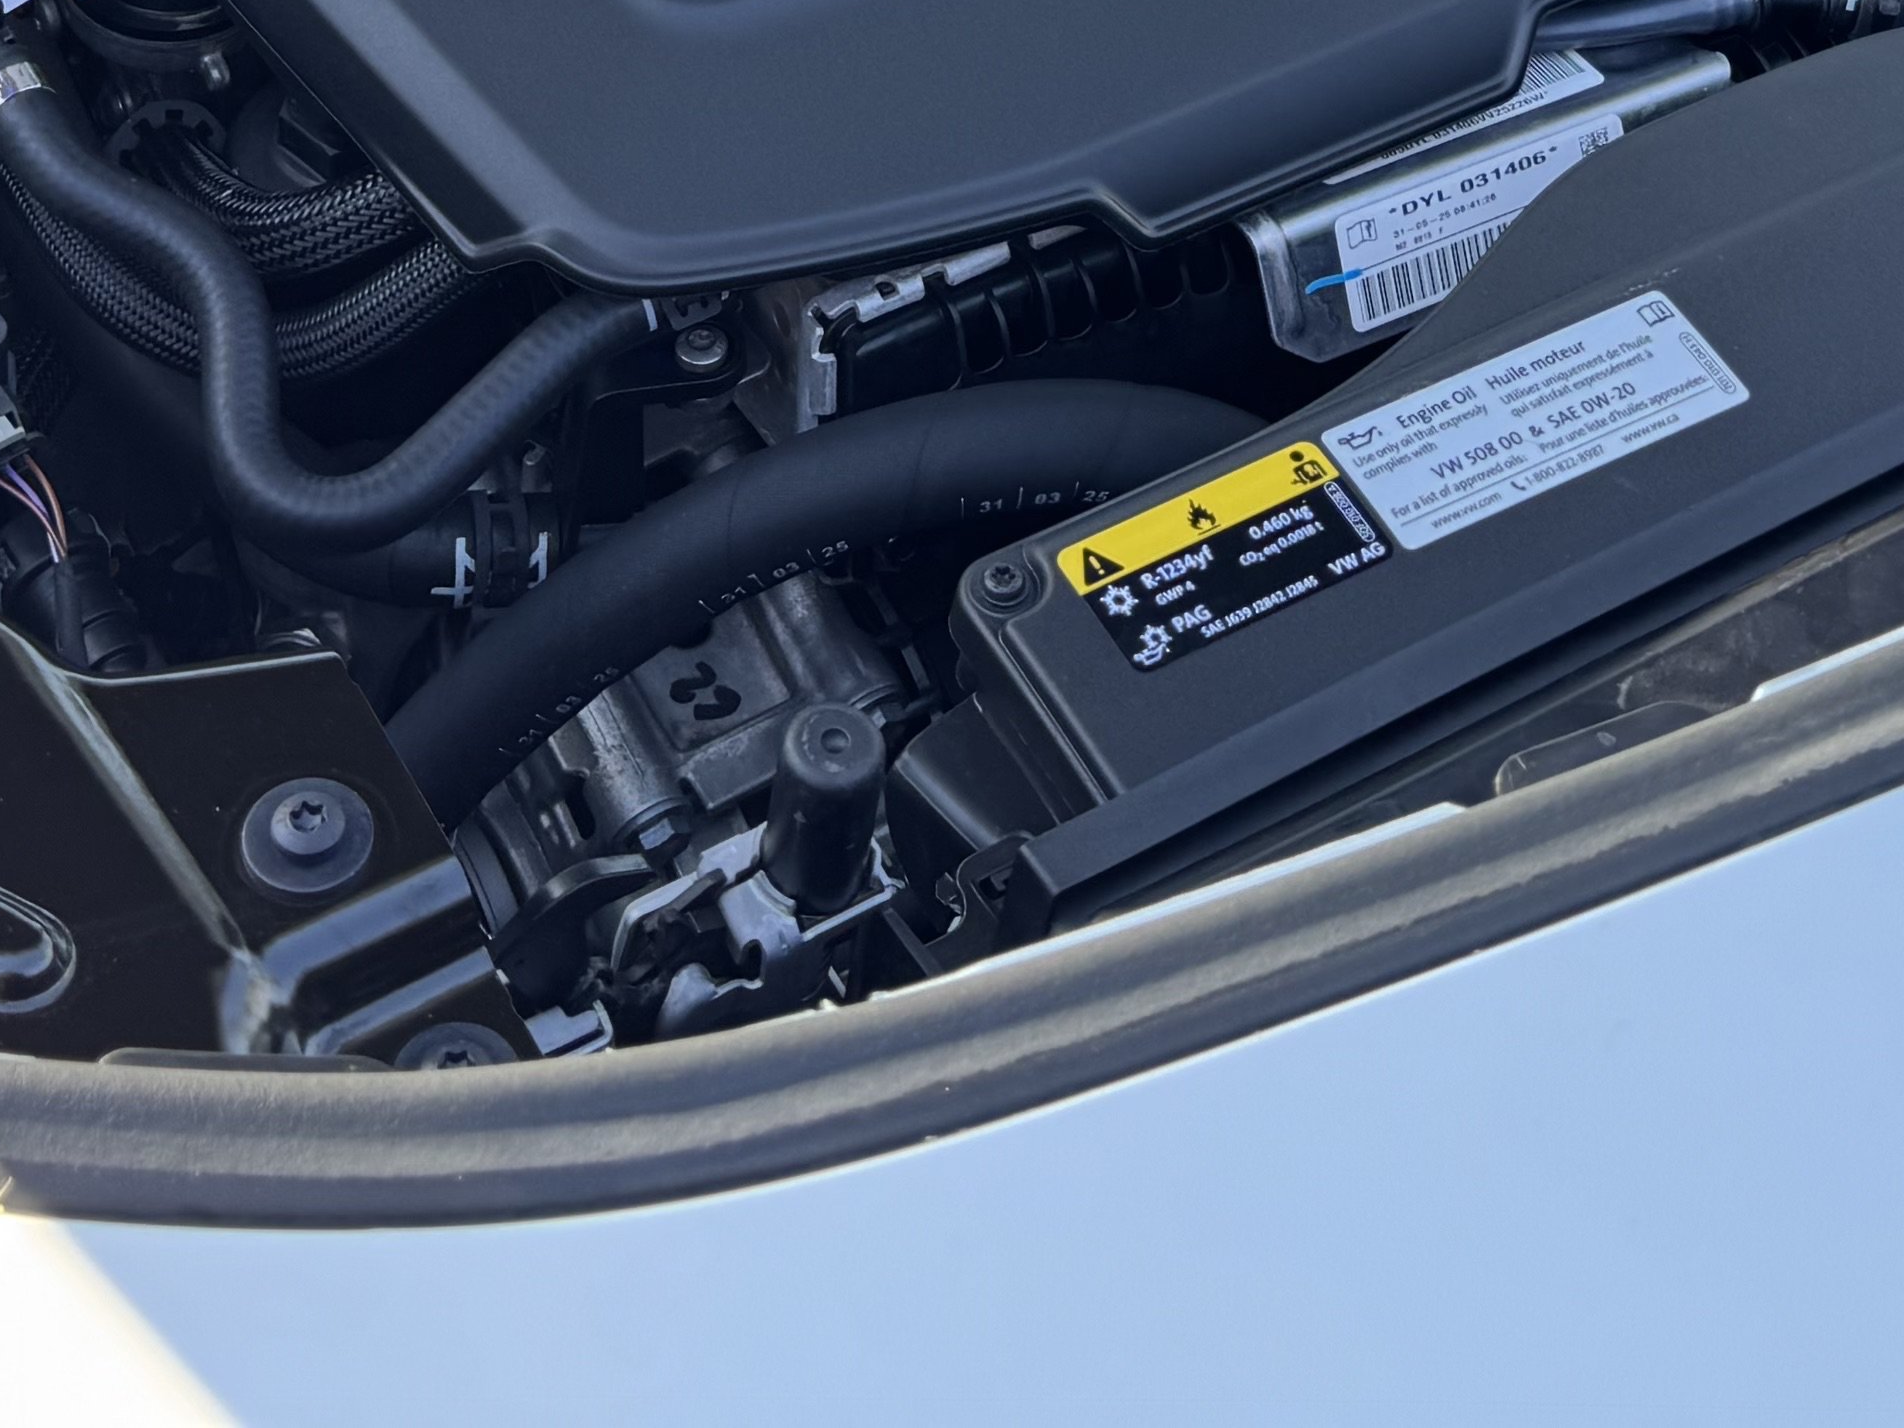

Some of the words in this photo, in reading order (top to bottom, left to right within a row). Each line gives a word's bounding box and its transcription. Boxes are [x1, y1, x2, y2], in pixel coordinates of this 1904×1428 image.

[1484, 362, 1531, 390] Huile
[1526, 338, 1588, 372] moteur
[1498, 380, 1542, 405] Utilisez
[1538, 353, 1609, 390] uniquement
[1602, 346, 1622, 360] de
[1508, 401, 1533, 419] qui
[1526, 383, 1573, 409] satisfait
[1642, 348, 1655, 359] à
[1394, 396, 1456, 432] Engine
[1448, 385, 1478, 406] Oil
[1351, 450, 1377, 468] Use
[1373, 440, 1403, 460] only
[1397, 434, 1416, 447] oil
[1412, 423, 1439, 441] that
[1436, 403, 1491, 433] expressly
[1429, 455, 1467, 480] VW
[1462, 440, 1500, 466] 508
[1495, 429, 1525, 451] 00
[1525, 422, 1546, 438] &
[1544, 405, 1582, 429] SAE
[1537, 435, 1566, 454] Pour
[1562, 426, 1587, 442] une
[1583, 415, 1610, 433] liste
[1360, 451, 1414, 482] complies
[1409, 440, 1439, 459] with
[1389, 502, 1412, 519] For
[1410, 499, 1421, 510] a
[1417, 490, 1439, 506] list
[1435, 483, 1454, 498] of
[1450, 461, 1507, 494] approved
[1429, 491, 1503, 529] www.vw.com
[1245, 510, 1294, 541] 0.460
[1288, 501, 1315, 524] kg
[1261, 542, 1281, 558] eq
[1275, 523, 1318, 548] 0.0018
[1314, 520, 1325, 531] t
[1137, 543, 1220, 593] R-1234yf
[1327, 552, 1361, 576] VW
[1357, 540, 1387, 562] AG
[1153, 583, 1187, 606] GWP
[1182, 579, 1196, 592] 4
[1198, 618, 1227, 638] SAE
[1222, 605, 1253, 626] J639
[1250, 590, 1287, 613] J2842
[1283, 574, 1319, 597] J2845
[1169, 603, 1213, 633] PAG
